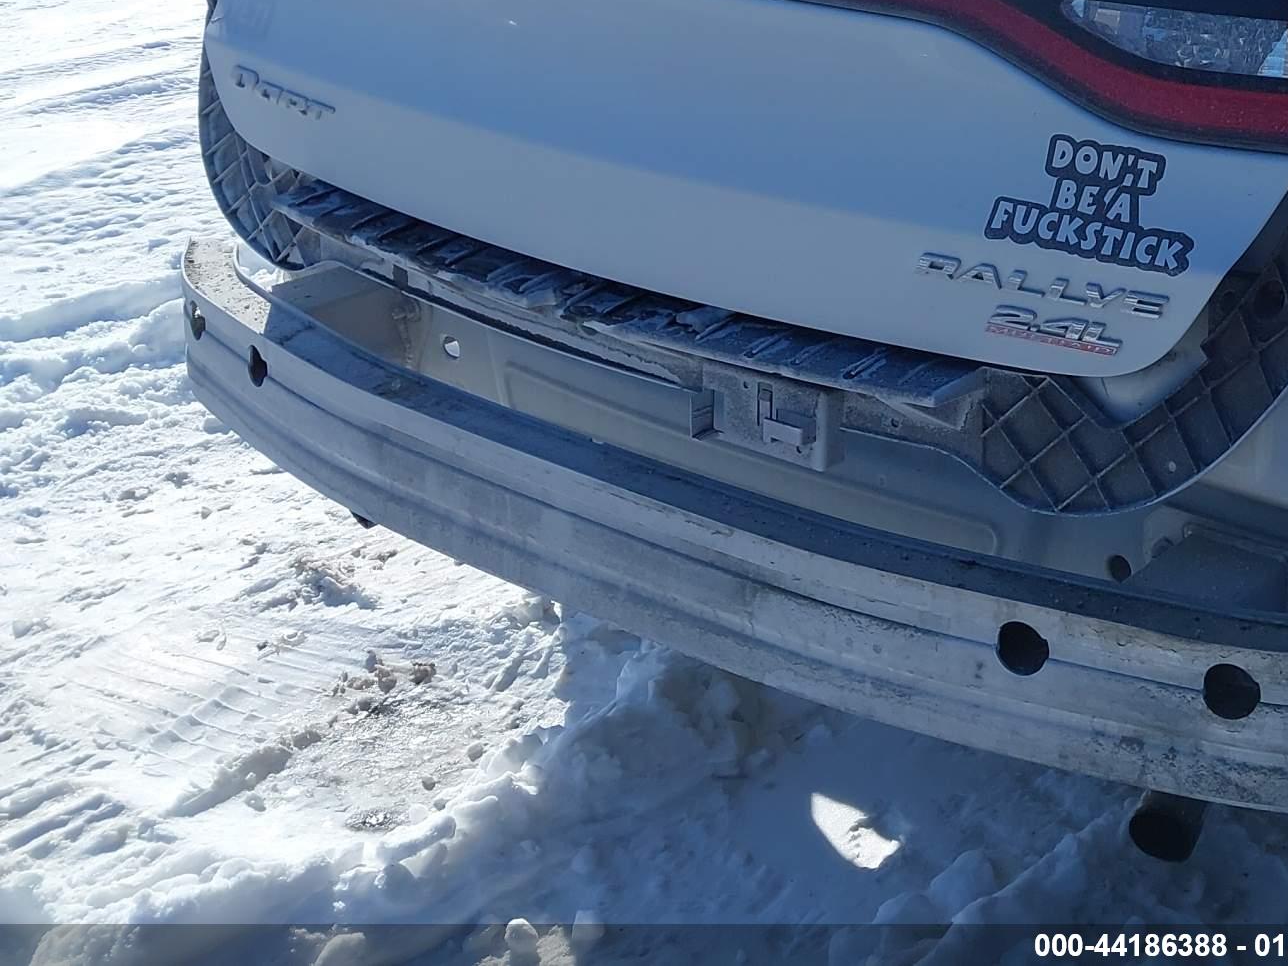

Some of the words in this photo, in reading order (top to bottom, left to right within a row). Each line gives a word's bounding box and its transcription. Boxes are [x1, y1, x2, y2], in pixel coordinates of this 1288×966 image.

[1051, 139, 1158, 188] DON'T
[1055, 179, 1100, 215] BE
[1105, 192, 1131, 223] A
[990, 200, 1183, 270] FUCKSTICK
[916, 252, 1170, 319] RALLYE
[987, 304, 1123, 347] 2.4L
